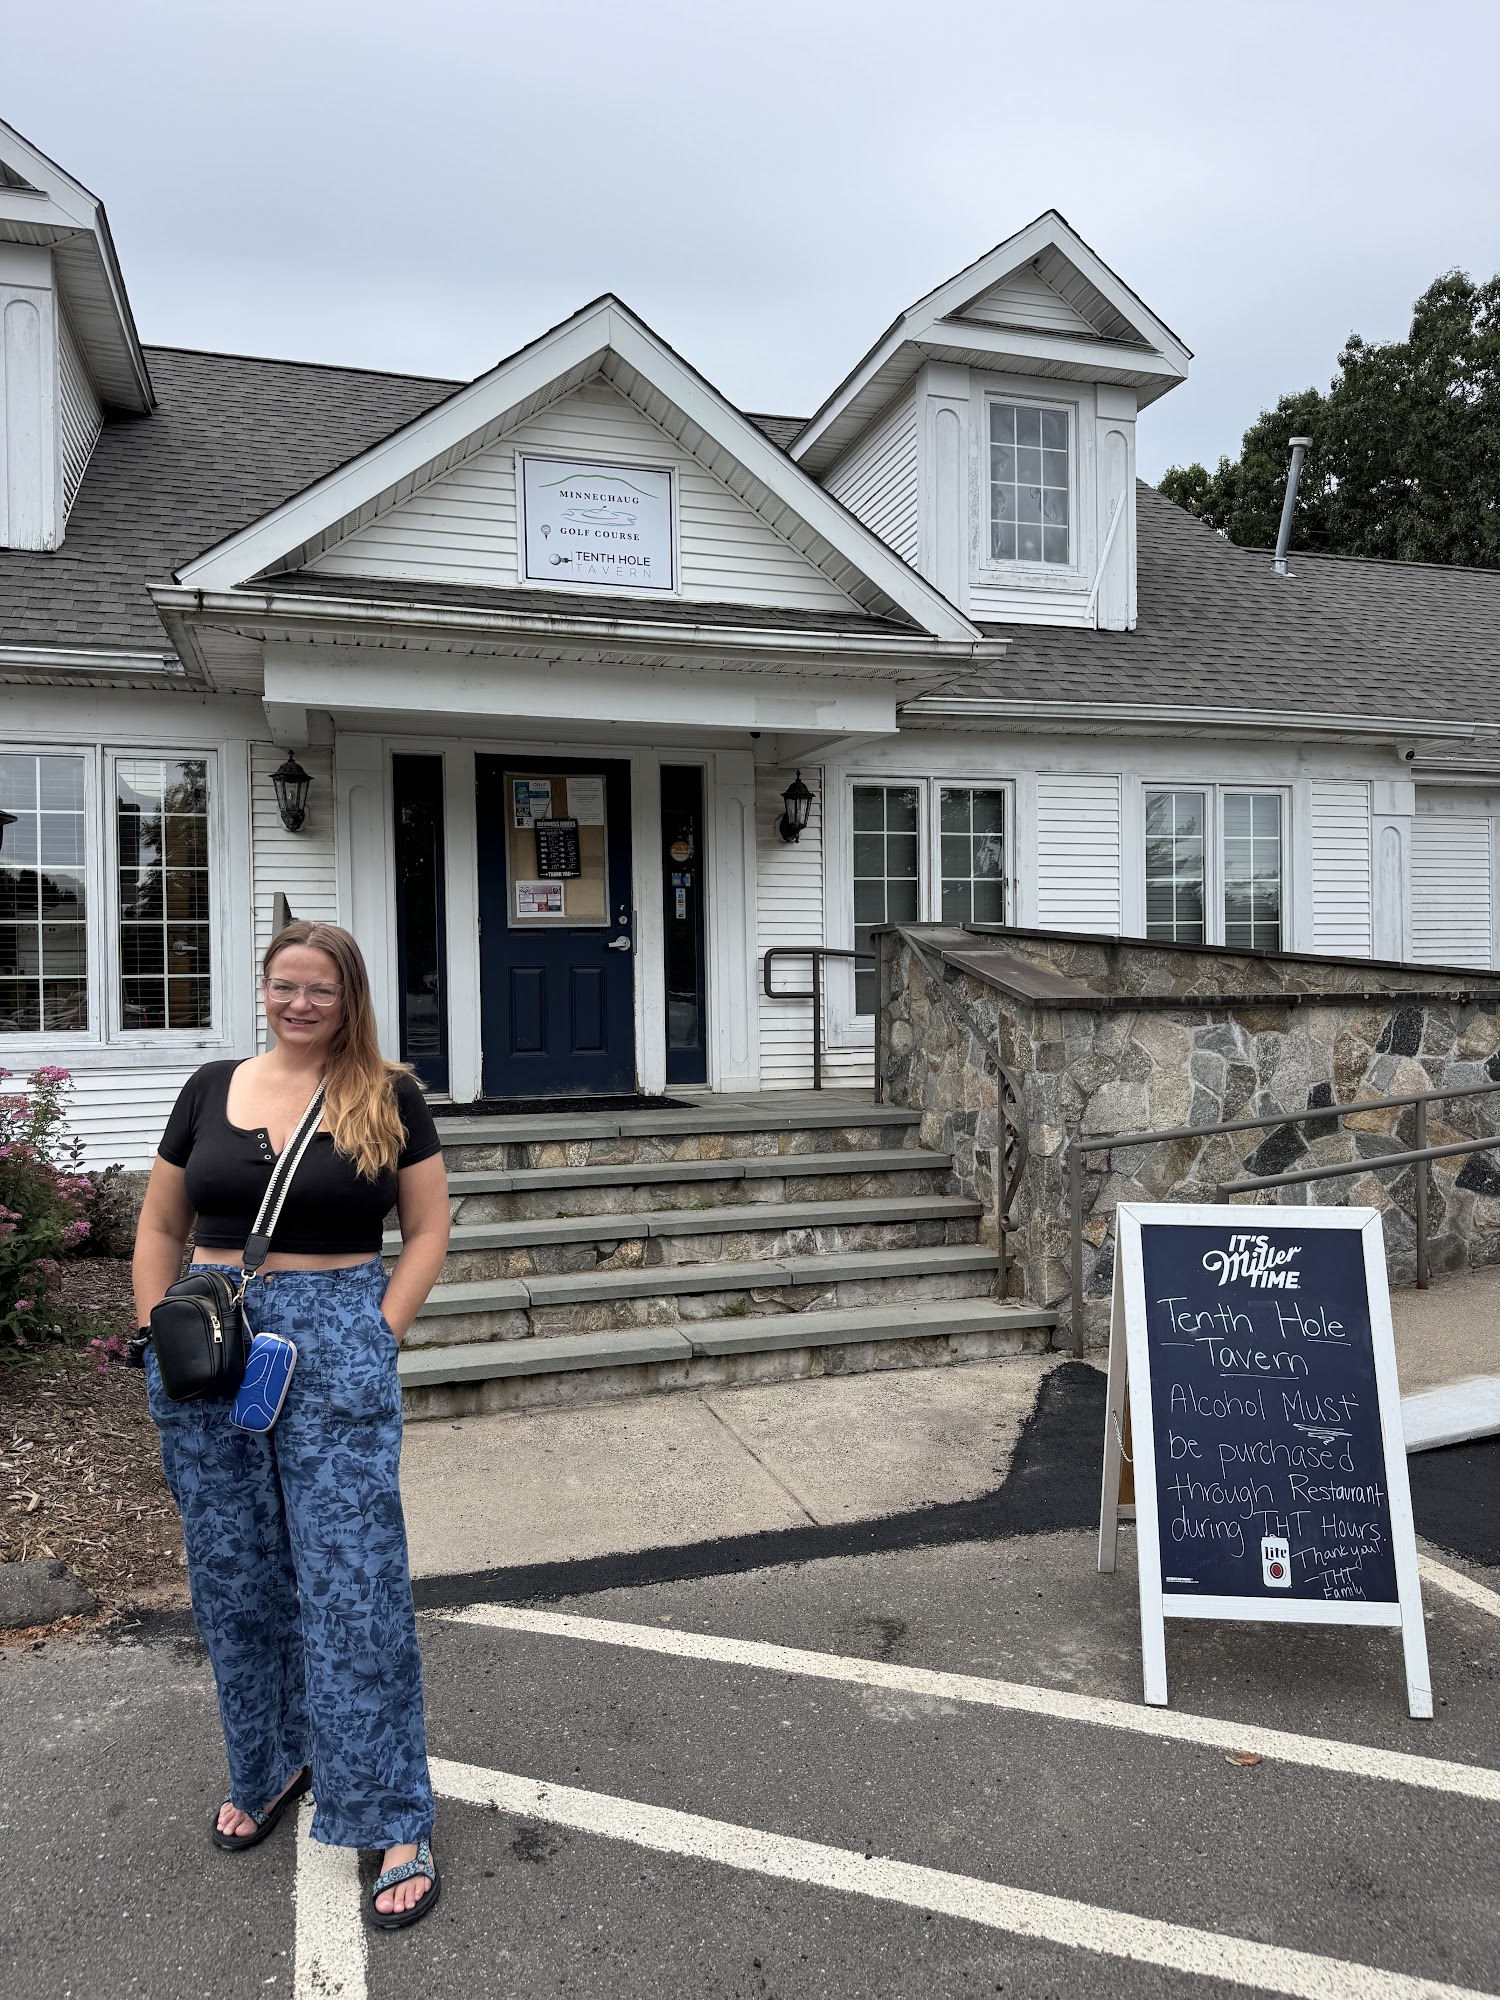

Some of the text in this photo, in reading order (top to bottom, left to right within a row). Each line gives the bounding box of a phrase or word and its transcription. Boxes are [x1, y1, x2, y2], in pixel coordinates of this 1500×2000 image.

[559, 490, 640, 504] MINNECHAUG
[560, 527, 640, 541] GOLF COURSE
[575, 551, 651, 567] TENTH HOLE
[576, 563, 651, 578] TAVERN
[1228, 1234, 1270, 1252] IT'S
[1202, 1246, 1302, 1286] Miller
[1156, 1297, 1346, 1339] Tenth Hole
[1195, 1337, 1309, 1376] Tavern
[1171, 1383, 1266, 1421] Alcohol
[1168, 1429, 1355, 1480] be purchased
[1167, 1472, 1385, 1520] through Restaurant
[1171, 1505, 1245, 1558] during
[1253, 1510, 1312, 1538] THT
[1263, 1546, 1288, 1562] Lite
[1291, 1544, 1350, 1570] Thank
[1323, 1582, 1367, 1600] Family
